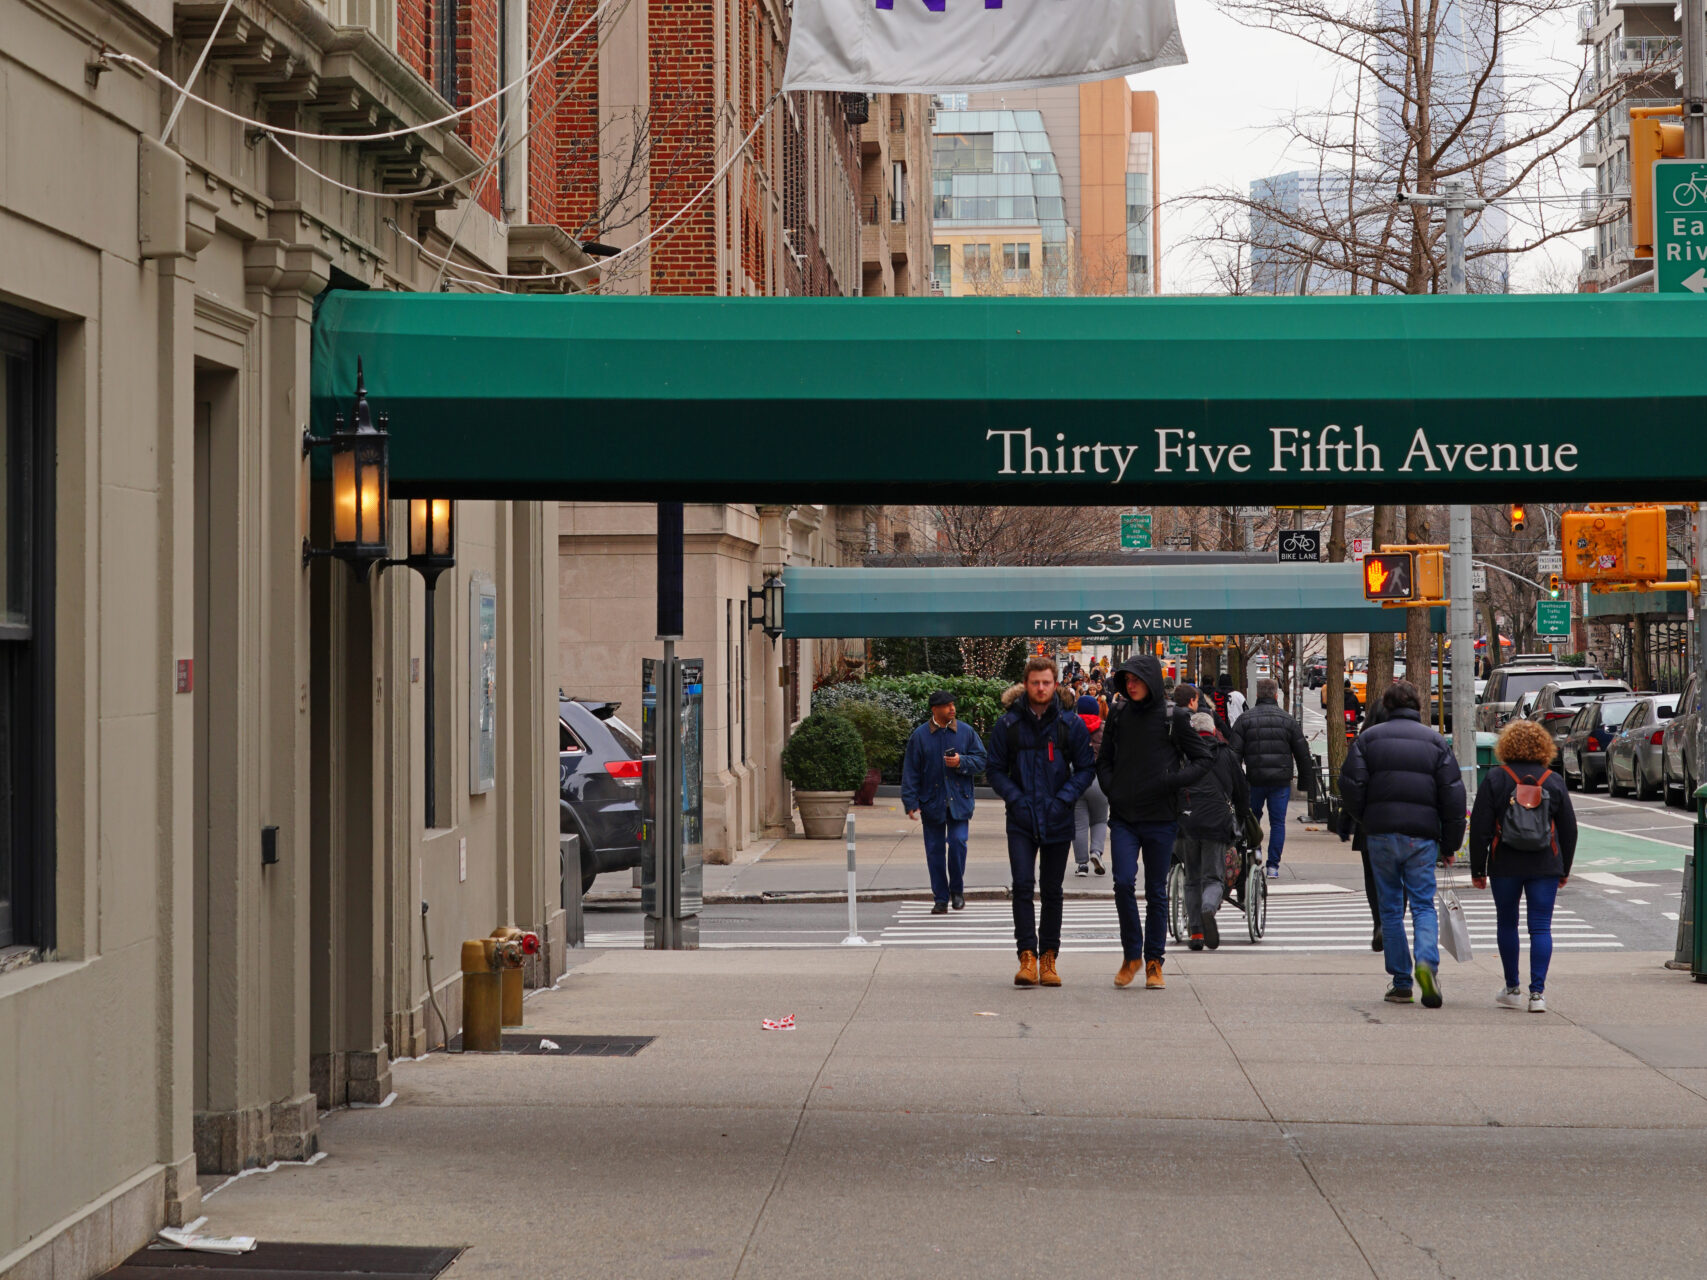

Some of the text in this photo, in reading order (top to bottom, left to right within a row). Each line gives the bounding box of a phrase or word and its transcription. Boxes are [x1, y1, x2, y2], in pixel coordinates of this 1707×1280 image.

[985, 424, 1579, 484] Thirty Five Fifth Avenue
[1034, 614, 1193, 633] FIFTH 33 AVENUE
